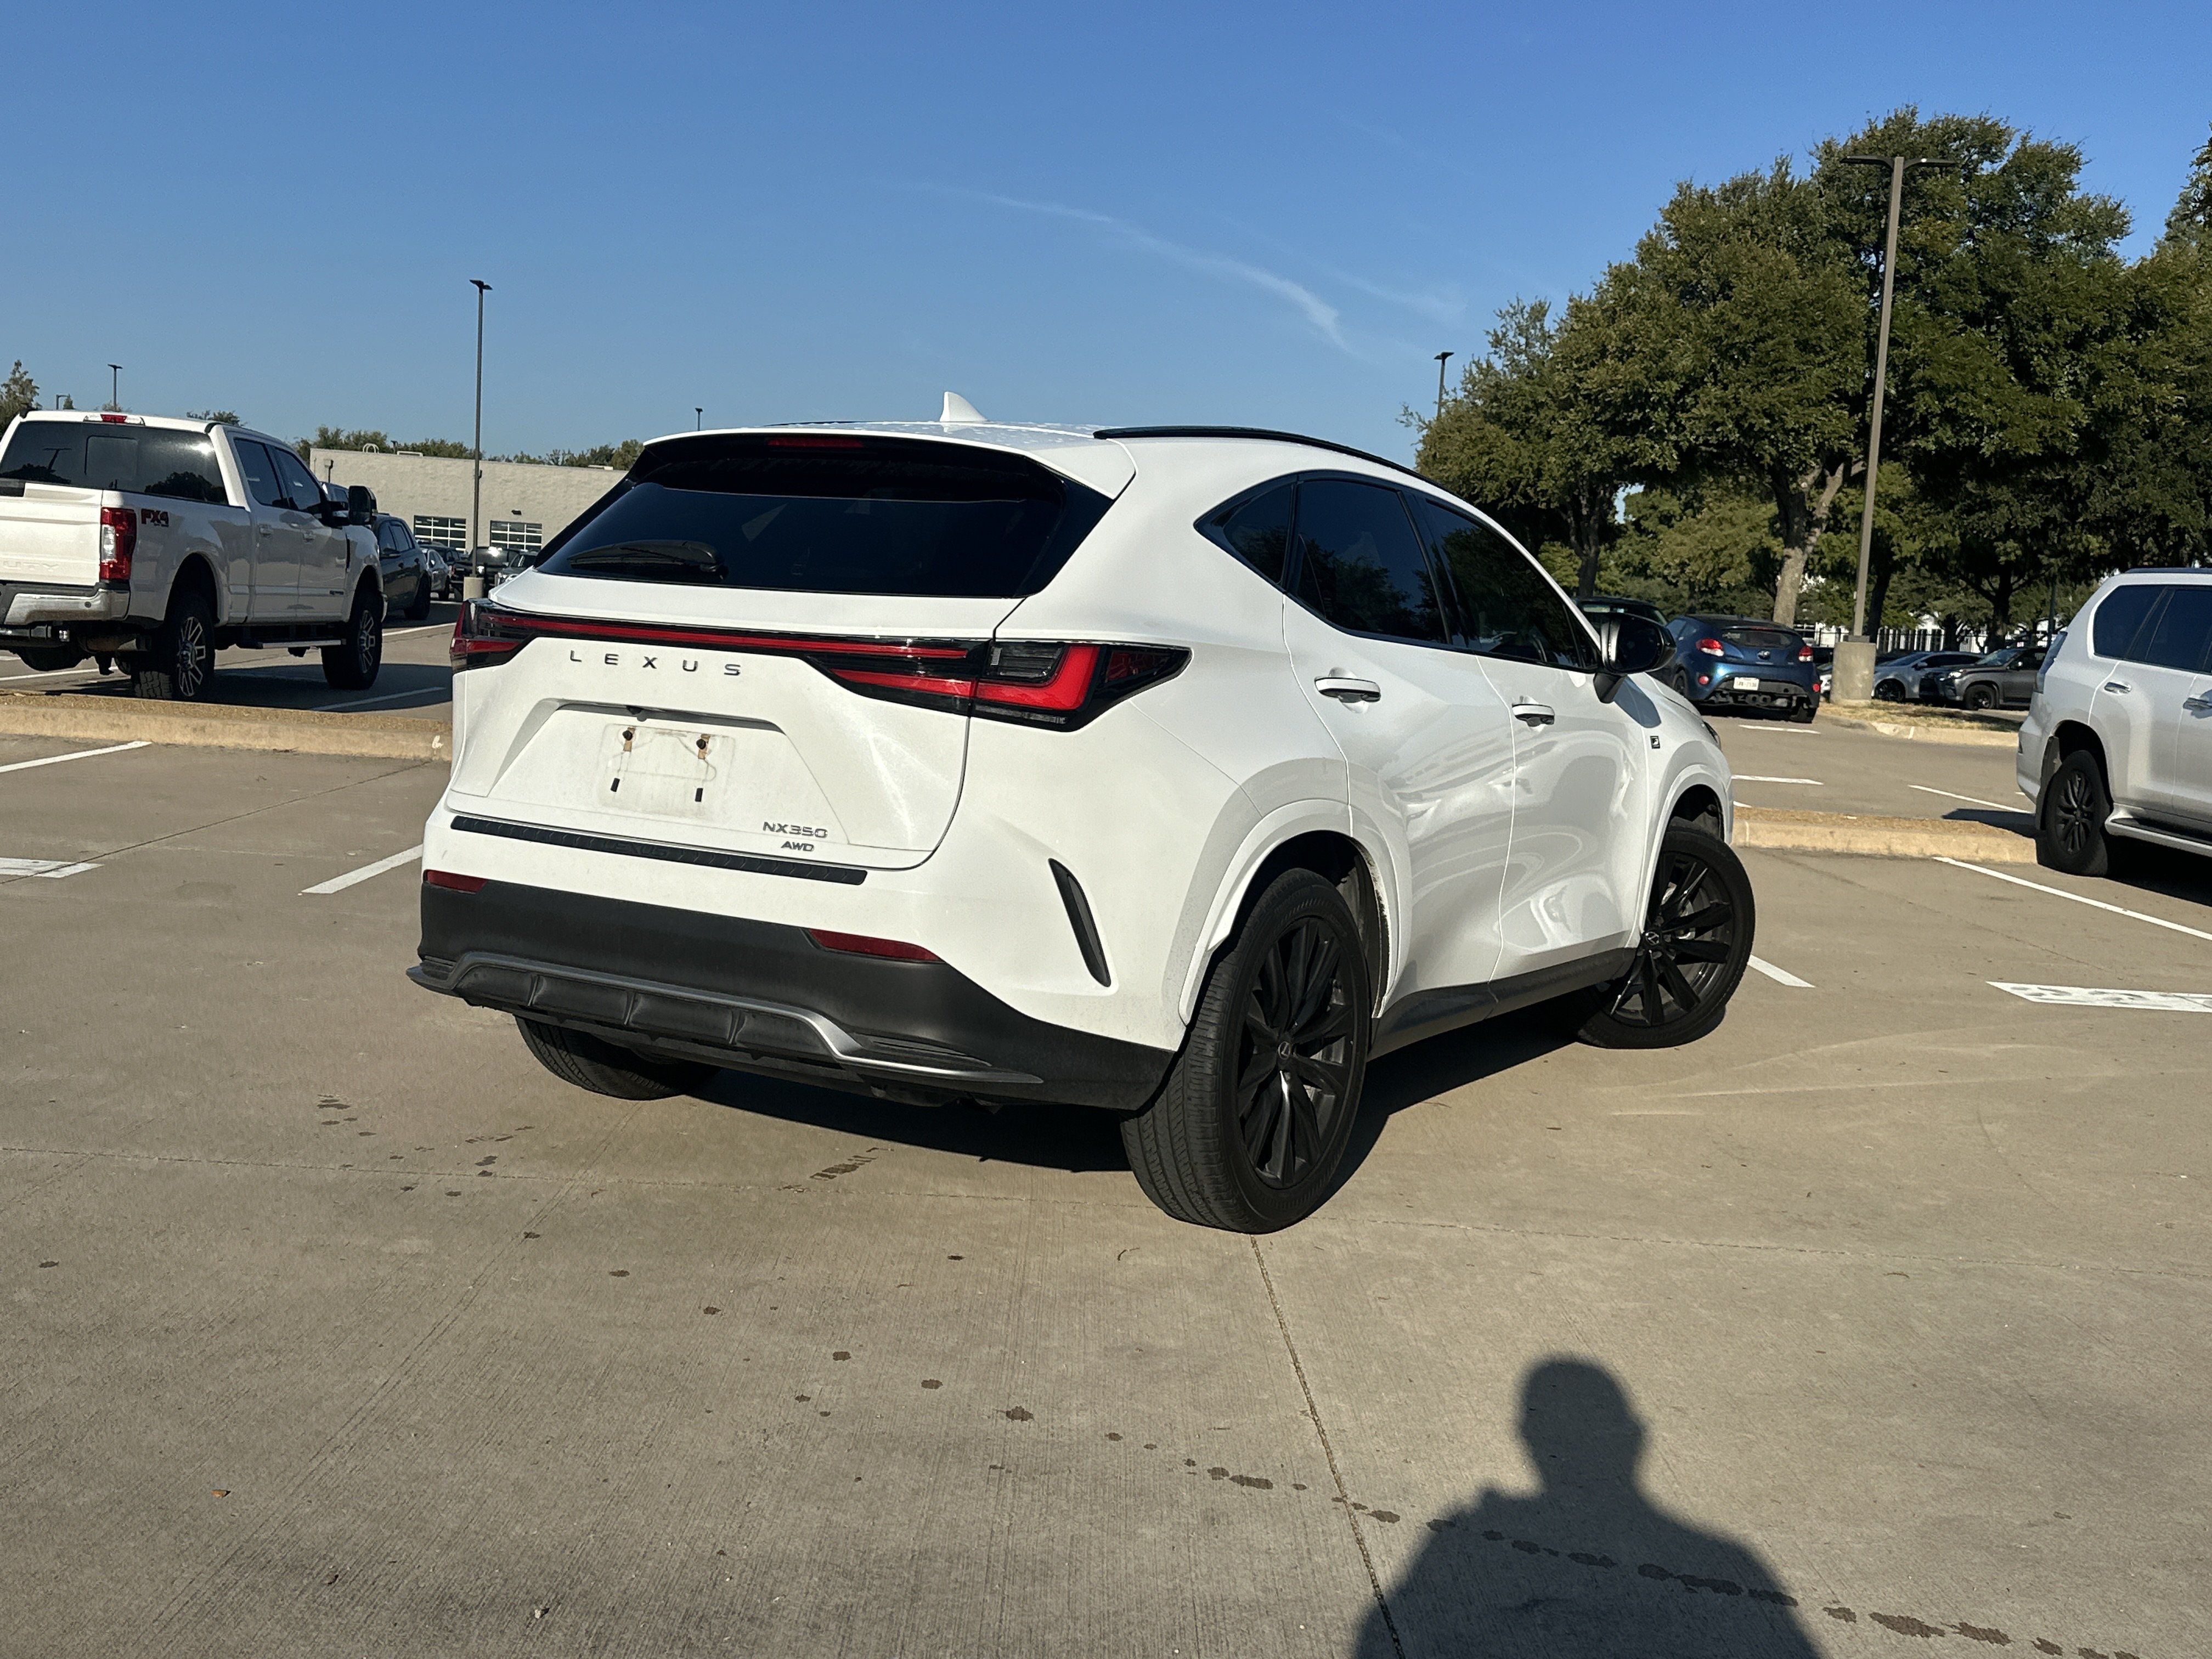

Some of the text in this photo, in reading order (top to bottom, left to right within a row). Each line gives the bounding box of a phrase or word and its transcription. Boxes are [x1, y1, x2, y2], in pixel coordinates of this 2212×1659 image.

[141, 509, 169, 524] FX4
[570, 650, 741, 676] LEXUS
[763, 821, 828, 838] NX350
[603, 839, 668, 857] LEXUS
[781, 841, 815, 851] AWD
